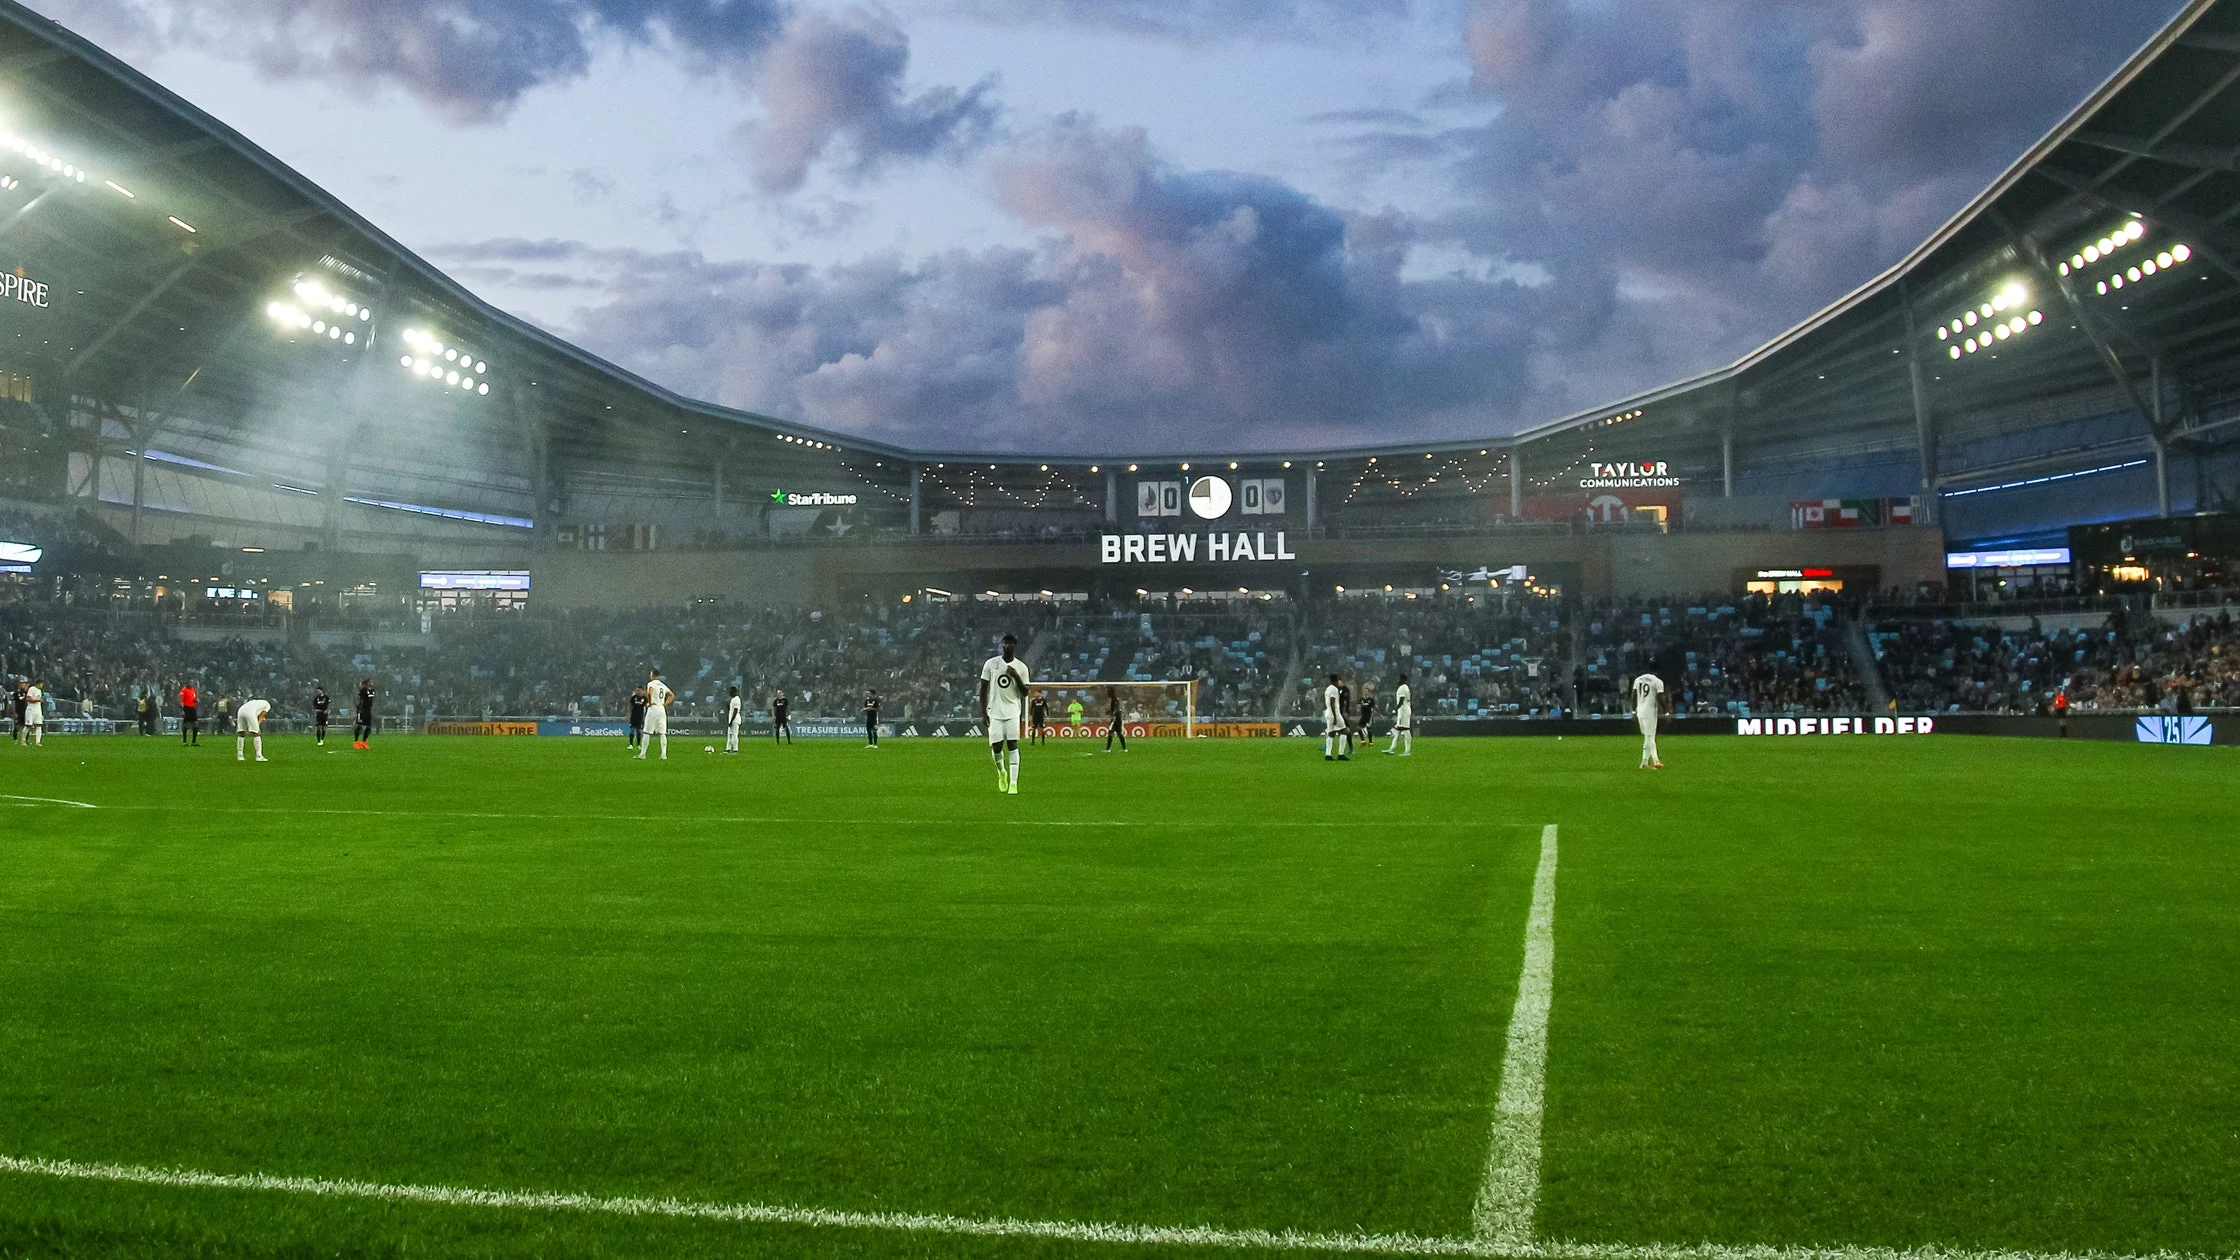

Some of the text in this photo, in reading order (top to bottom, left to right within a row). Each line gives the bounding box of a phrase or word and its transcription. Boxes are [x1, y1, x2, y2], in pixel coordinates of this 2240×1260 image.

[1591, 461, 1667, 477] TAYLOR
[1580, 478, 1680, 488] COMMUNICATIONS
[788, 493, 857, 505] StarTribune
[1101, 531, 1296, 563] BREW HALL
[658, 687, 664, 699] 8
[1639, 682, 1650, 698] 19
[427, 723, 534, 736] Continental TIRE
[584, 727, 624, 736] SeatGeek
[796, 726, 868, 734] TREASURE ISLAN
[1246, 728, 1277, 737] TIRE
[2164, 716, 2180, 743] 25
